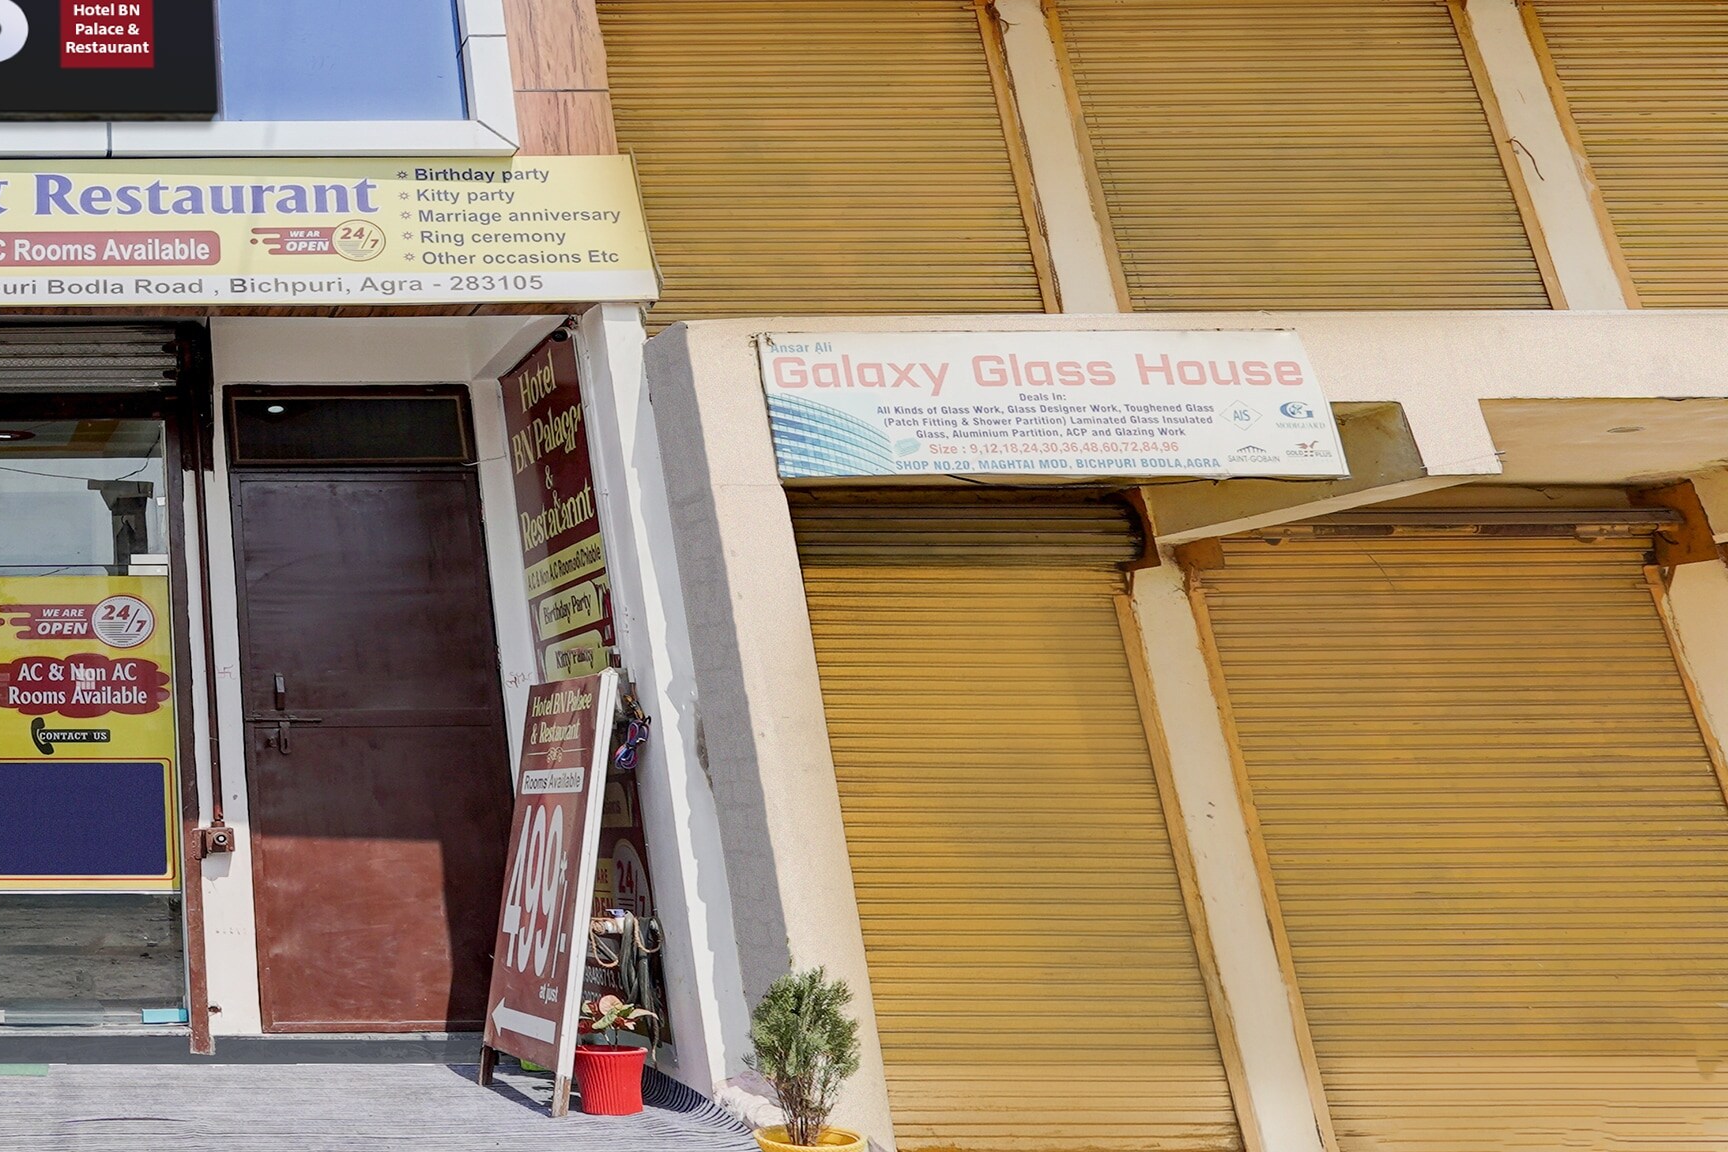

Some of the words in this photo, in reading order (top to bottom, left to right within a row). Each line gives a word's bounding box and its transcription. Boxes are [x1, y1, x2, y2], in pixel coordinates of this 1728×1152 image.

[73, 3, 114, 16] Hotel
[118, 4, 140, 16] BN
[75, 22, 124, 35] Palace
[127, 23, 140, 35] &
[65, 41, 149, 53] Restaurant
[414, 168, 495, 184] Birthday
[501, 167, 549, 183] party
[34, 173, 379, 217] Restaurant
[416, 188, 459, 204] Kitty
[467, 188, 515, 204] party
[418, 208, 502, 225] Marriage
[508, 208, 620, 224] anniversary
[286, 241, 329, 251] OPEN
[340, 227, 379, 249] 24/7
[420, 230, 465, 247] Ring
[471, 230, 566, 245] ceremony
[14, 239, 97, 260] Rooms
[102, 237, 210, 260] Available
[422, 251, 476, 264] Other
[482, 250, 581, 264] occasions
[588, 249, 619, 263] Etc
[47, 278, 124, 295] Bodla
[135, 278, 204, 294] Road
[230, 277, 351, 297] Bichpuri,
[359, 276, 423, 295] Agra
[450, 275, 544, 292] 283105
[771, 343, 809, 353] Ansar
[814, 342, 832, 353] Ali
[518, 349, 557, 415] Hotel
[772, 354, 949, 396] Galaxy
[972, 353, 1116, 388] Glass
[1135, 353, 1304, 386] House
[1019, 393, 1049, 402] Deals
[1052, 393, 1066, 401] In:
[877, 406, 890, 415] All
[894, 406, 924, 415] Kinds
[927, 406, 937, 415] of
[941, 405, 970, 415] Glass
[973, 405, 1004, 415] Work,
[1007, 404, 1037, 414] Glass
[1040, 404, 1086, 415] Designer
[1090, 404, 1121, 415] Work,
[1124, 403, 1182, 414] Toughened
[1185, 403, 1214, 413] Glass
[1233, 409, 1250, 421] AIS
[883, 417, 919, 427] (Patch
[923, 417, 958, 428] Fitting
[961, 417, 970, 426] &
[973, 416, 1012, 426] Shower
[1016, 416, 1066, 427] Partition)
[1070, 415, 1127, 425] Laminated
[1130, 415, 1159, 425] Glass
[1162, 414, 1213, 424] Insulated
[916, 429, 949, 440] Glass,
[952, 428, 1009, 438] Aluminium
[1012, 428, 1063, 439] Partition,
[1066, 428, 1087, 437] ACP
[1091, 427, 1111, 436] and
[1115, 427, 1155, 438] Glazing
[1158, 427, 1185, 436] Work
[511, 425, 536, 475] BN
[929, 444, 959, 454] Size
[895, 460, 928, 470] SHOP
[979, 459, 1035, 470] MAGHTAI
[1076, 458, 1137, 469] BICHPURI
[1228, 455, 1281, 463] SAINT-GOBAIN
[545, 464, 554, 489] &
[43, 608, 61, 617] WE
[62, 608, 85, 617] ARE
[101, 604, 147, 632] 24/7
[544, 599, 571, 624] Birthday
[37, 622, 88, 635] OPEN
[17, 663, 43, 681] AC
[48, 663, 64, 681] &
[71, 663, 106, 681] Non
[112, 663, 137, 681] AC
[8, 686, 66, 704] Rooms
[71, 686, 148, 705] Available
[532, 694, 554, 717] Hotel
[552, 692, 567, 714] BN
[566, 688, 592, 712] Palace
[39, 732, 88, 741] CONTACT
[94, 732, 108, 740] US
[530, 723, 538, 744] &
[539, 719, 580, 743] Restaurant
[524, 774, 548, 790] Rooms
[548, 772, 581, 789] Available
[593, 897, 614, 918] PEN
[539, 985, 546, 1000] at
[545, 983, 558, 1004] just
